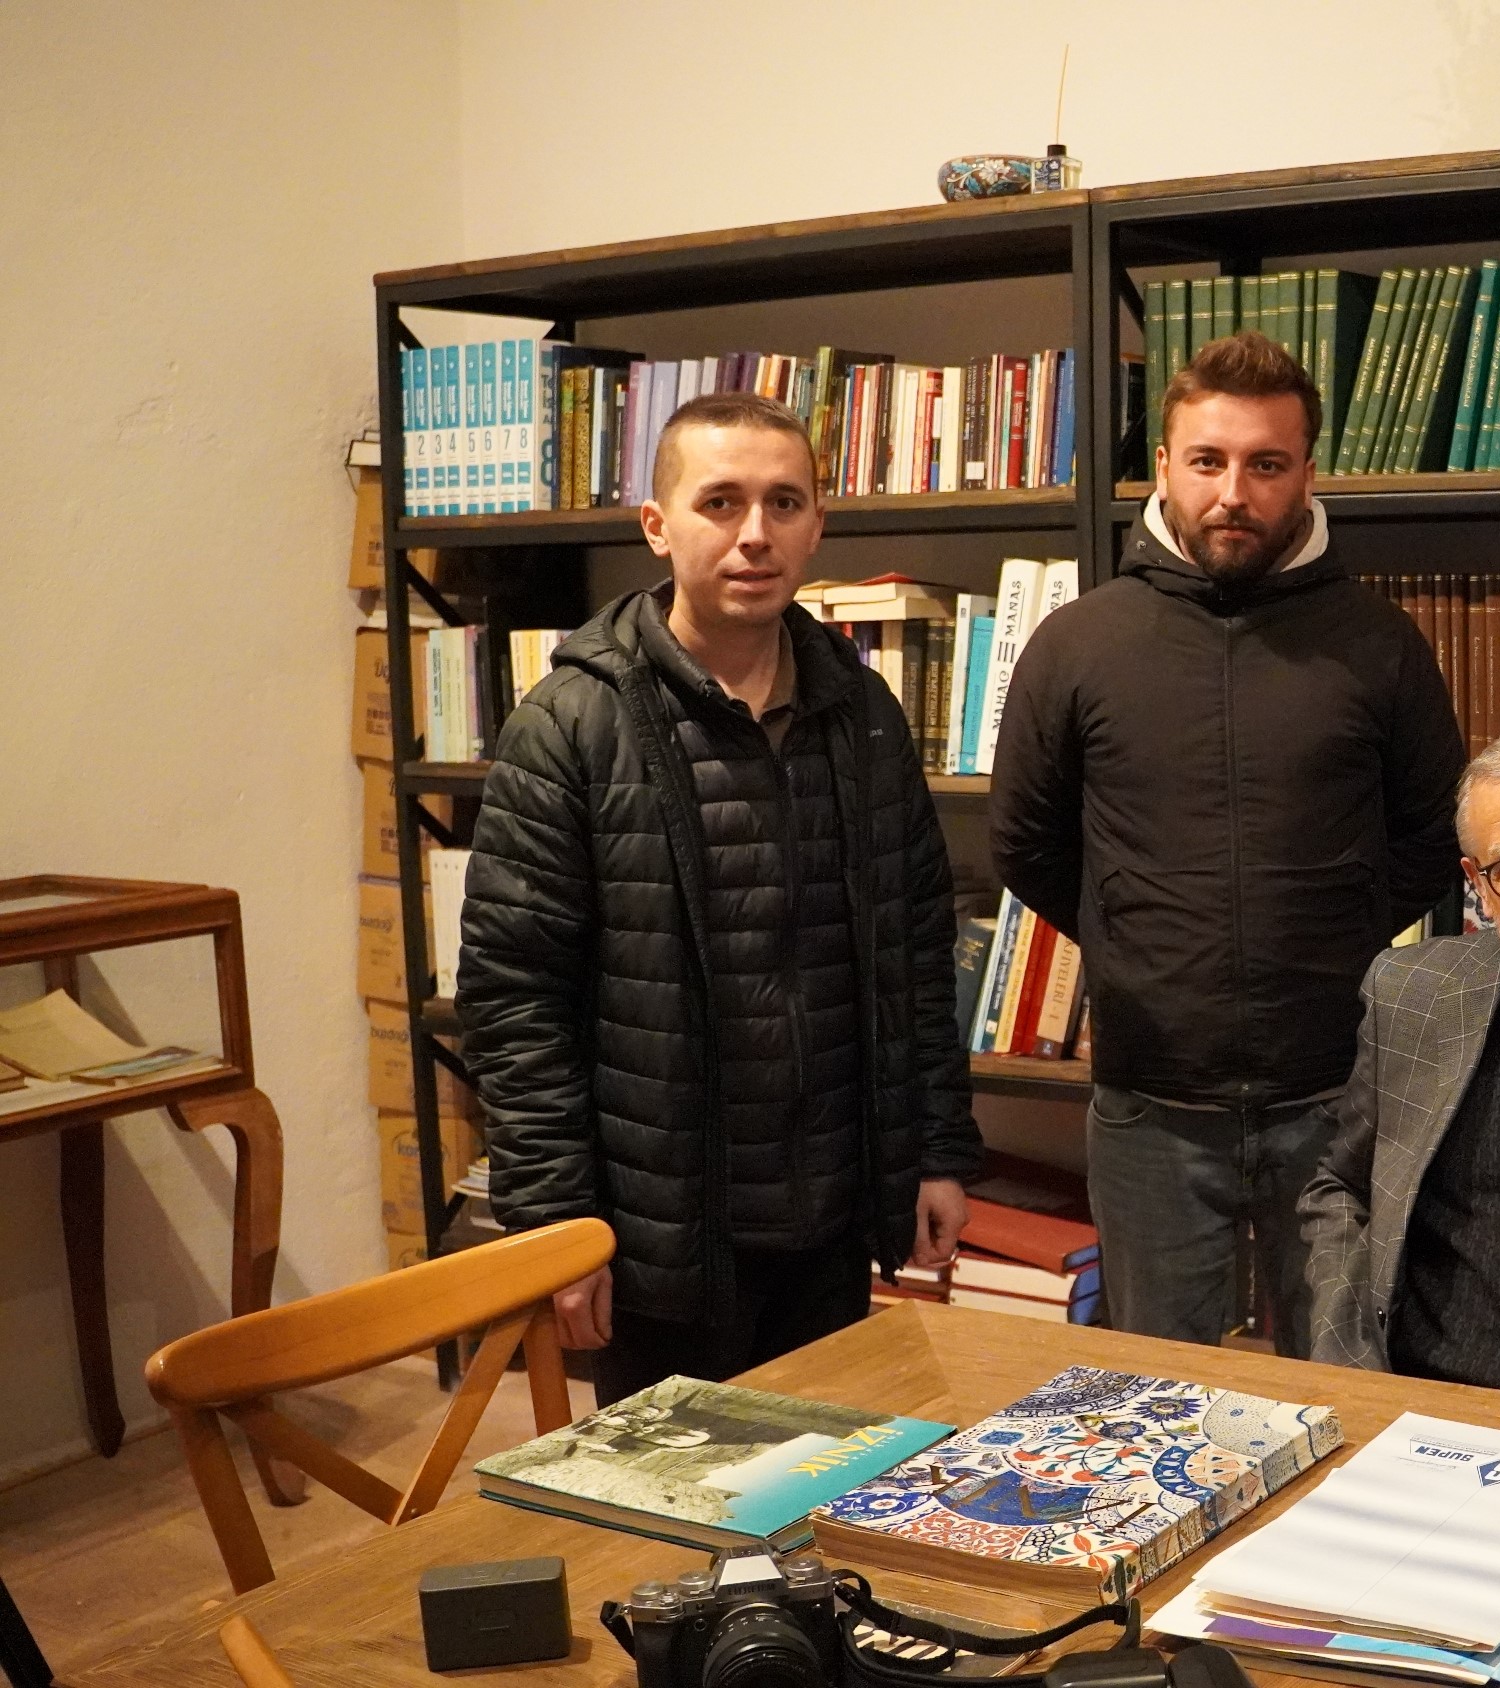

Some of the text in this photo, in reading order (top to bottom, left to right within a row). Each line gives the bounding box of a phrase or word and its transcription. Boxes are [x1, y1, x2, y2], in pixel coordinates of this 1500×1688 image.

[418, 435, 424, 456] 2
[435, 434, 442, 455] 3
[449, 432, 456, 452] 4
[468, 432, 475, 452] 5
[484, 431, 492, 451] 6
[504, 429, 511, 450] 7
[520, 428, 528, 448] 8
[1049, 581, 1064, 612] NAS
[1004, 581, 1021, 636] MANAS
[1053, 937, 1074, 1004] KFİYELERİ
[786, 1426, 904, 1478] İZNİK
[1415, 1445, 1474, 1462] SUPEN
